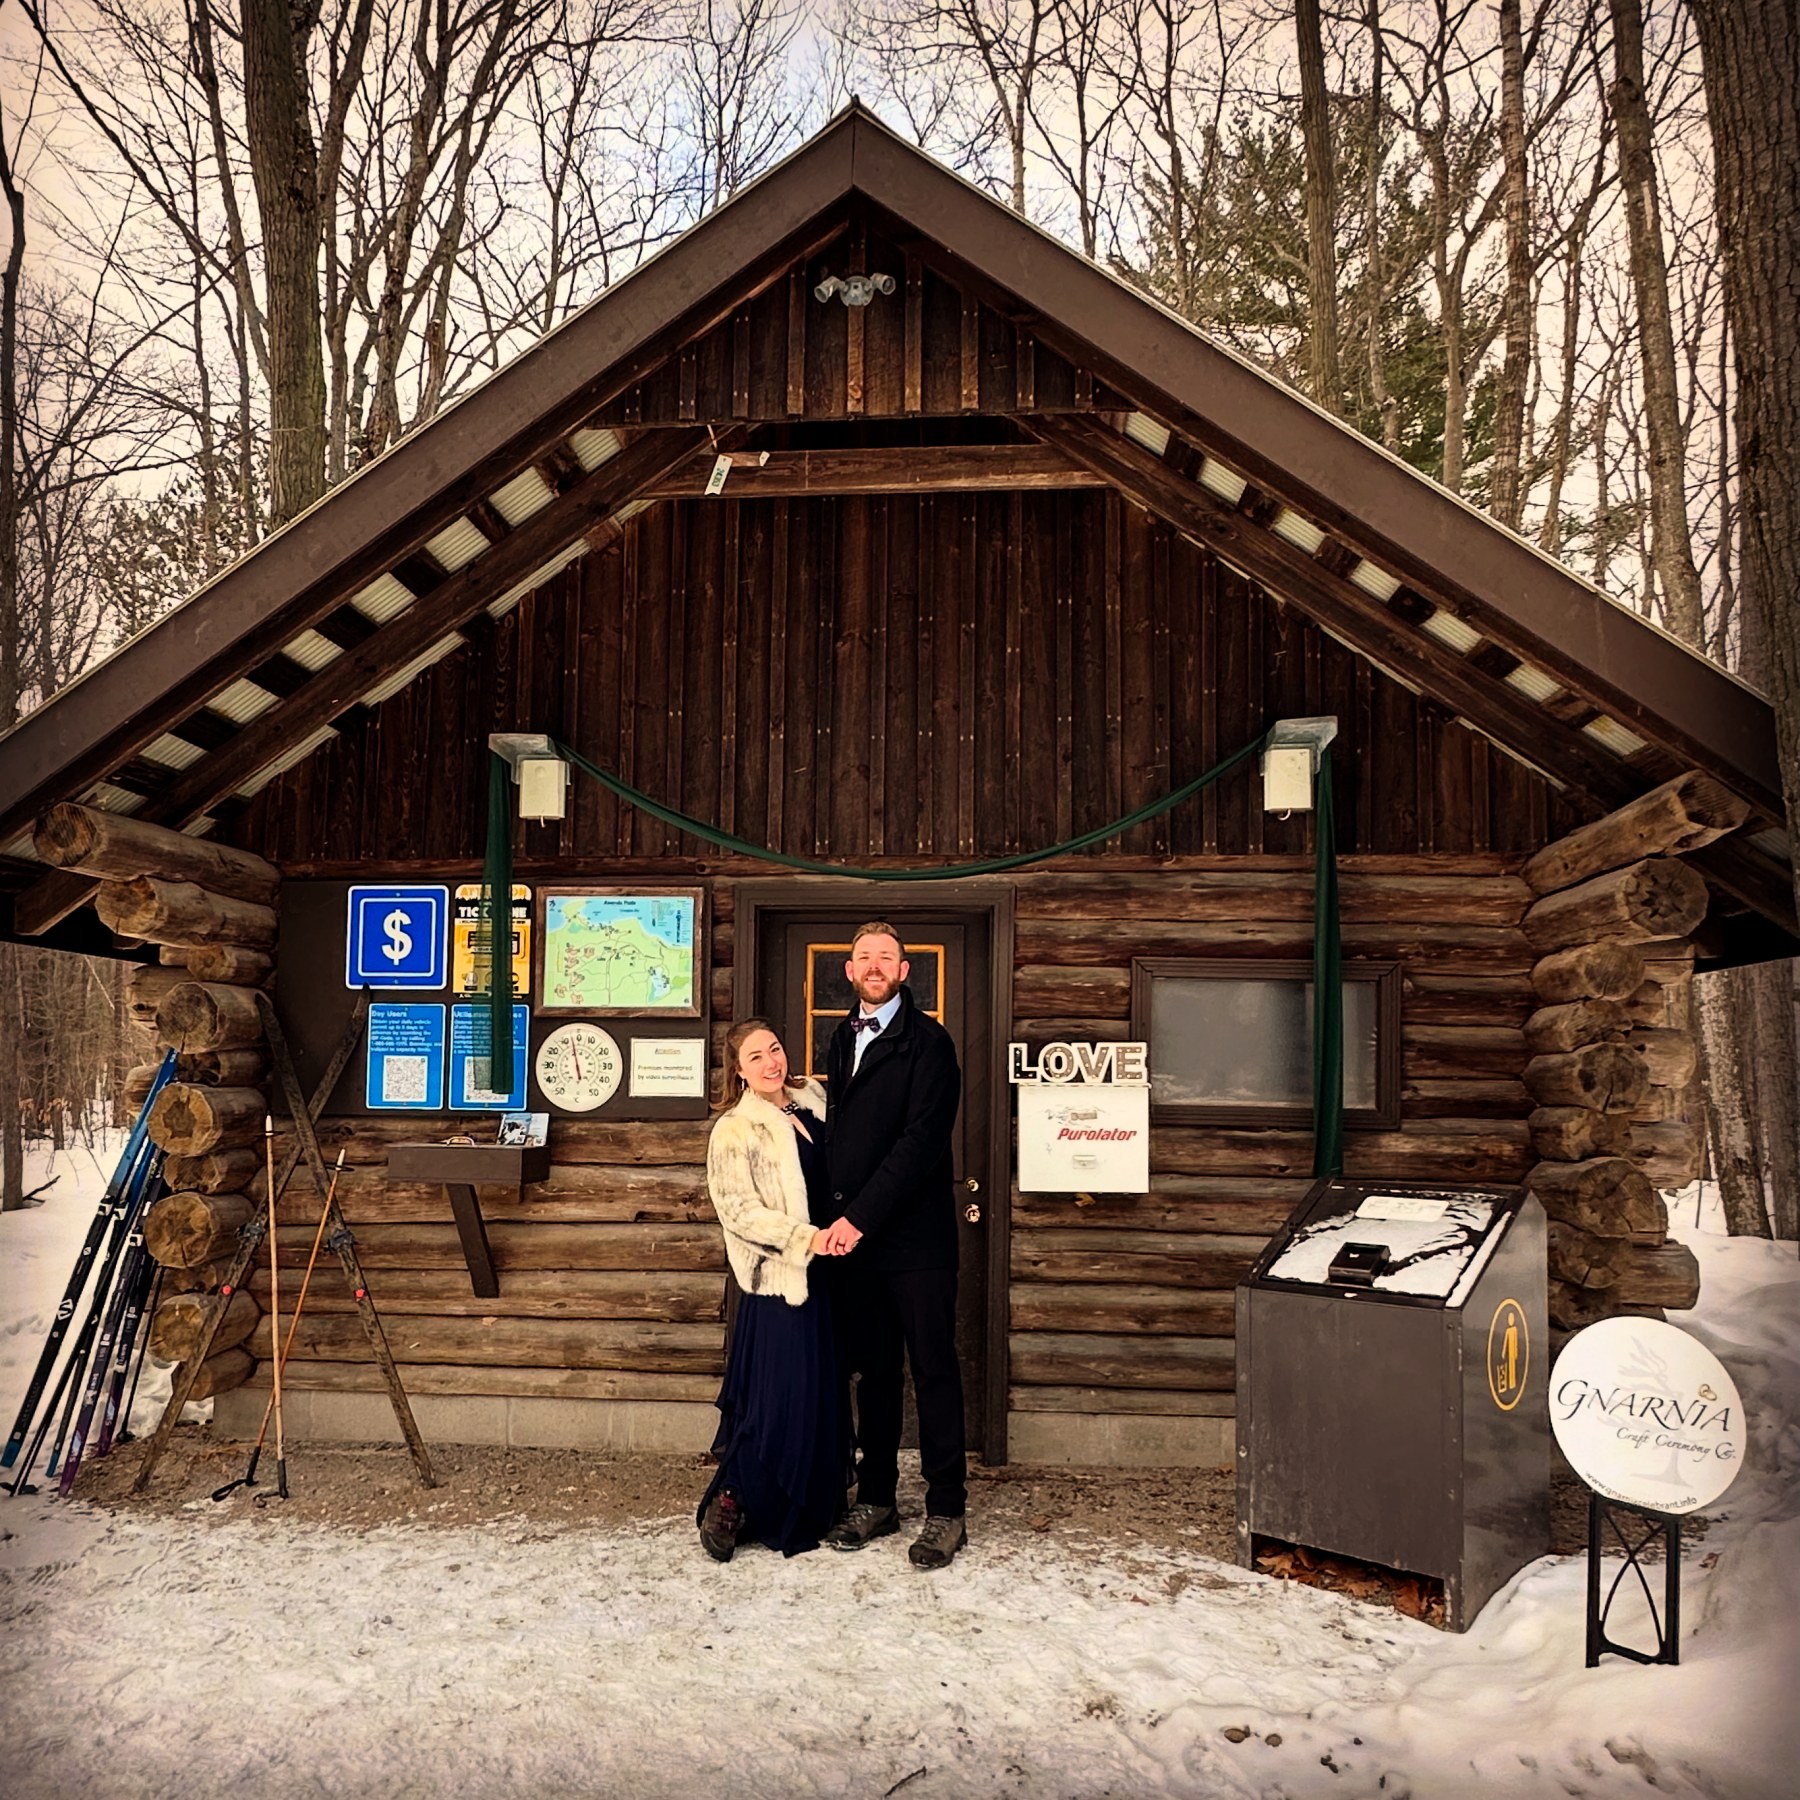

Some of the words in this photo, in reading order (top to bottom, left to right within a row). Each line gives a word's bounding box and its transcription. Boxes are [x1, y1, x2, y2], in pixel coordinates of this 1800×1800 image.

[387, 1010, 407, 1018] Users
[587, 1036, 595, 1044] 10
[599, 1047, 609, 1055] 20
[602, 1062, 613, 1070] 30
[1010, 1043, 1146, 1083] LOVE
[589, 1088, 599, 1096] 50
[1057, 1128, 1137, 1141] Purolator
[1557, 1379, 1731, 1432] GNARNIA
[1616, 1427, 1650, 1448] Craft
[1655, 1434, 1711, 1462] Ceremony
